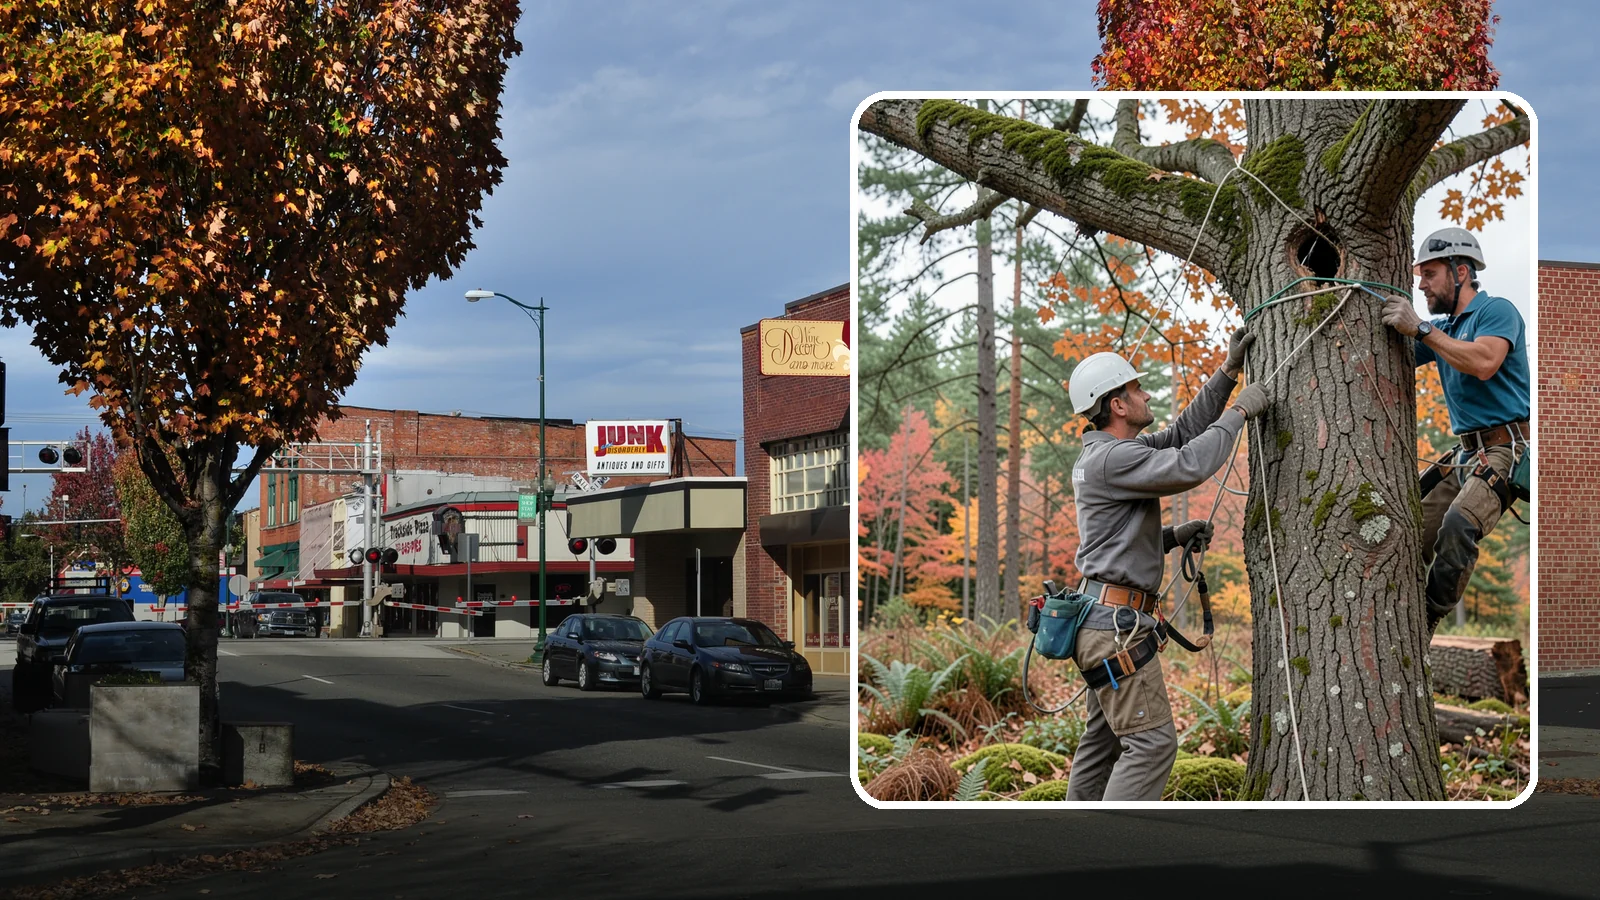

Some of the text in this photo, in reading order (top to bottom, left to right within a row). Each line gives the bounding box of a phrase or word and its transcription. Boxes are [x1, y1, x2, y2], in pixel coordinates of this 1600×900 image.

[595, 425, 665, 457] JUNK
[607, 446, 646, 454] DISORDERLY
[596, 460, 665, 470] ANTIQUES AND GIFTS
[414, 519, 429, 535] Pizza
